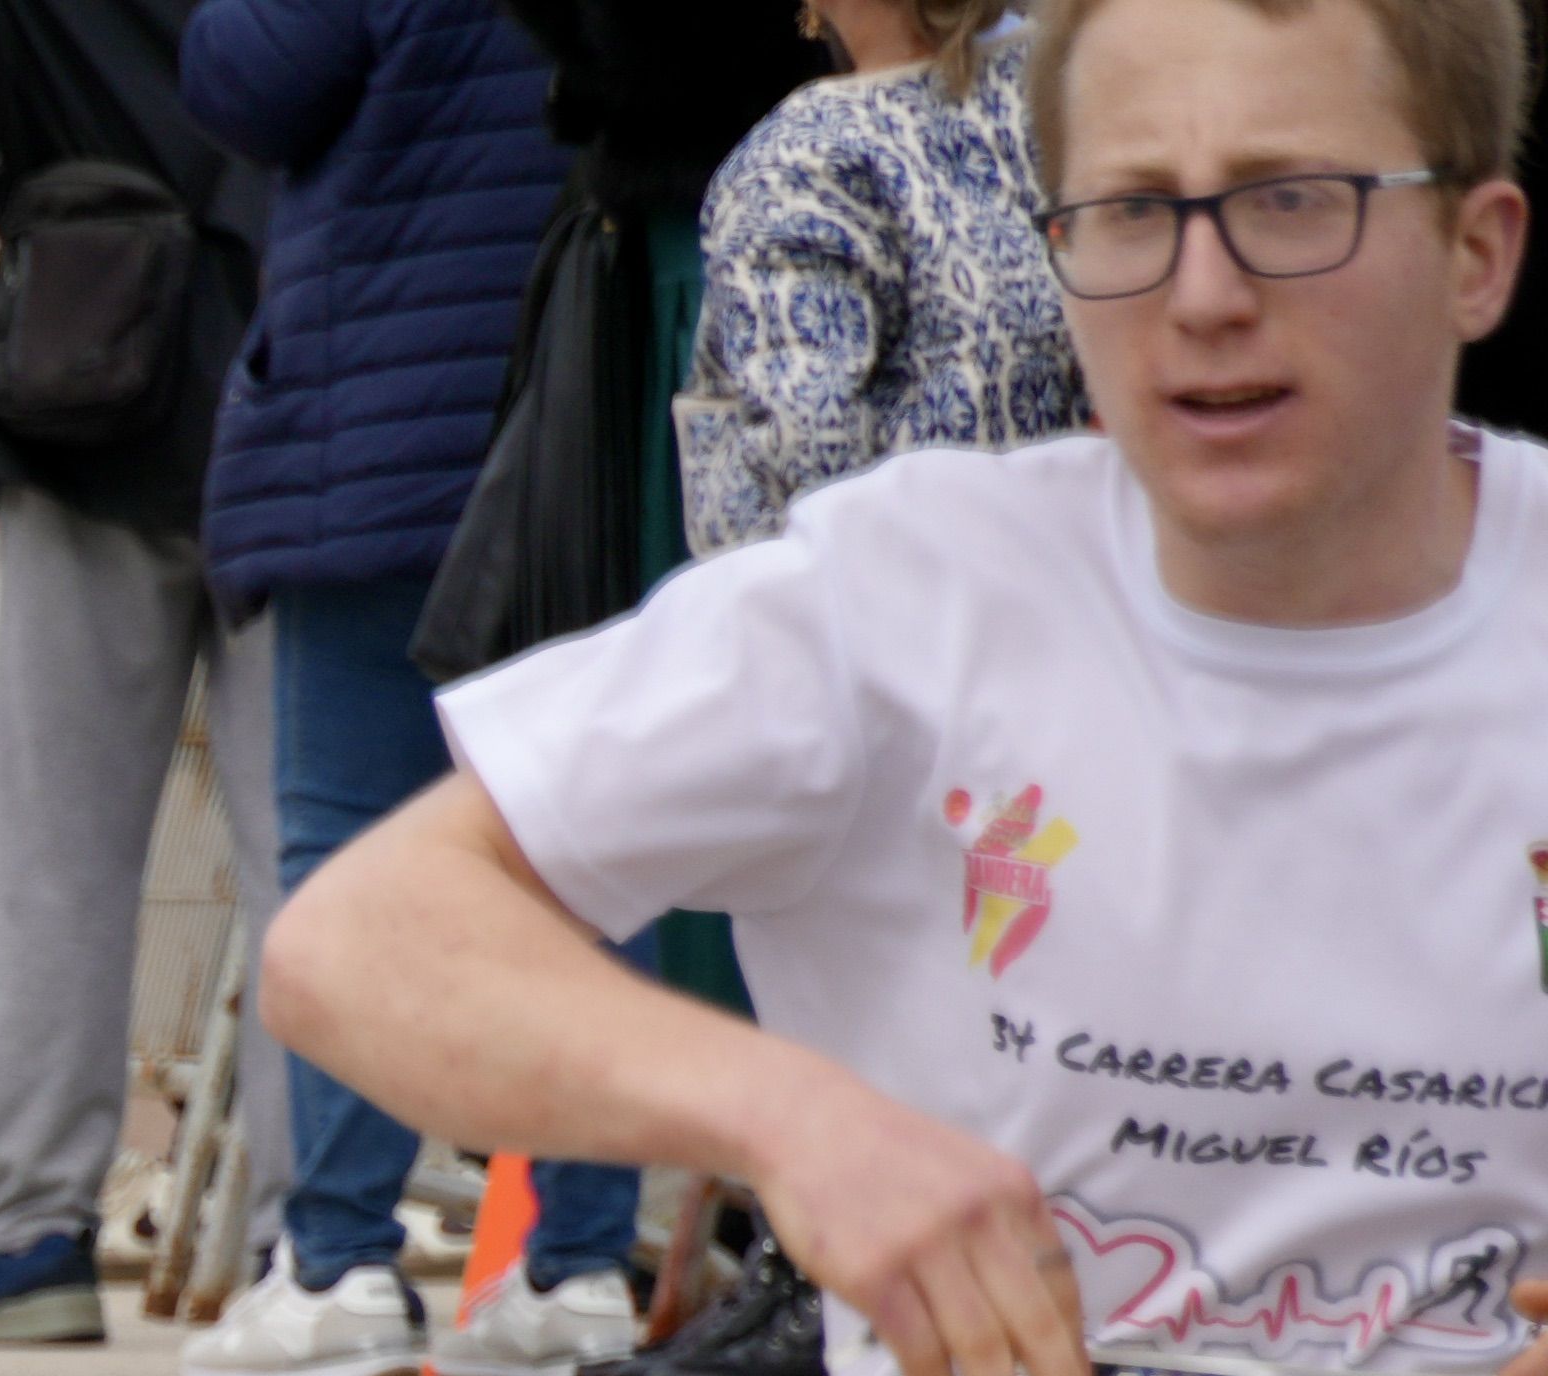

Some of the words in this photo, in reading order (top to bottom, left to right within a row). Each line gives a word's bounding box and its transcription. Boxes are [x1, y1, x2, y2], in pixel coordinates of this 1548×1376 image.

[1055, 1032, 1291, 1094] CARRERA
[1111, 1116, 1328, 1168] MIGUEL
[1355, 1127, 1488, 1184] RÍOS
